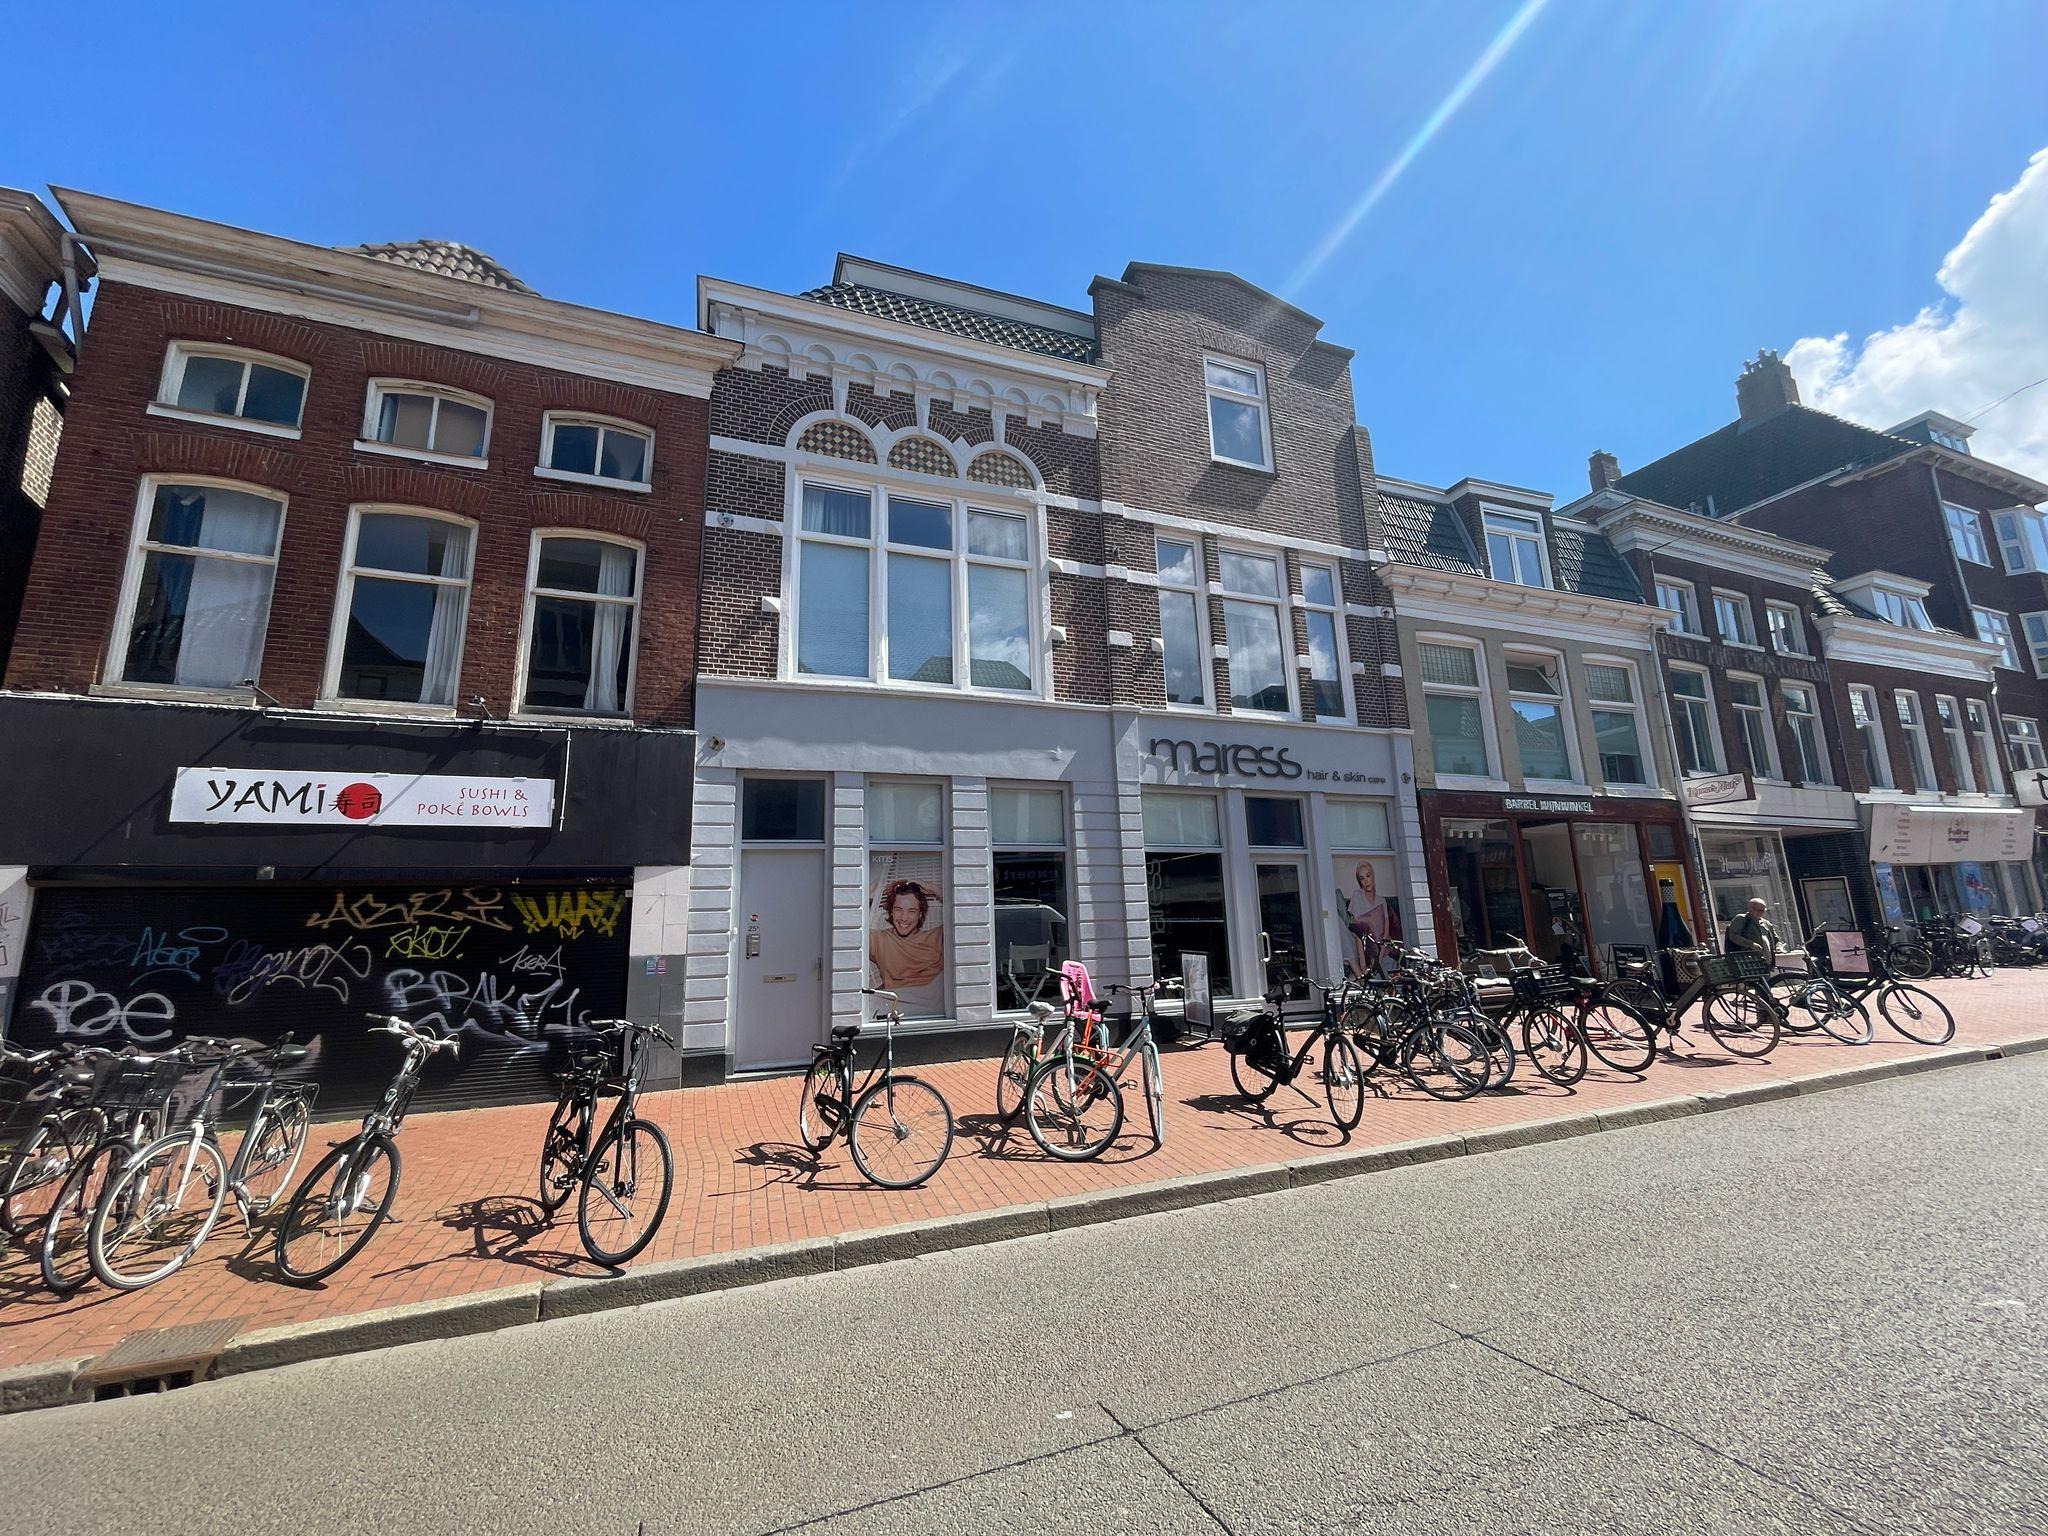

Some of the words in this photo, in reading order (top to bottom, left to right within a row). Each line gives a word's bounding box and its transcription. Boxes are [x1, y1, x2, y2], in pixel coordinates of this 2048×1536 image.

[1150, 738, 1302, 778] maress
[1307, 769, 1328, 781] hair
[1332, 771, 1341, 782] &
[1344, 771, 1366, 784] skin
[460, 787, 507, 800] SUSHI
[514, 789, 528, 800] &
[417, 802, 464, 815] POKÉ
[472, 805, 528, 817] BOWLS
[1505, 798, 1539, 810] BARREL
[872, 855, 894, 863] kms
